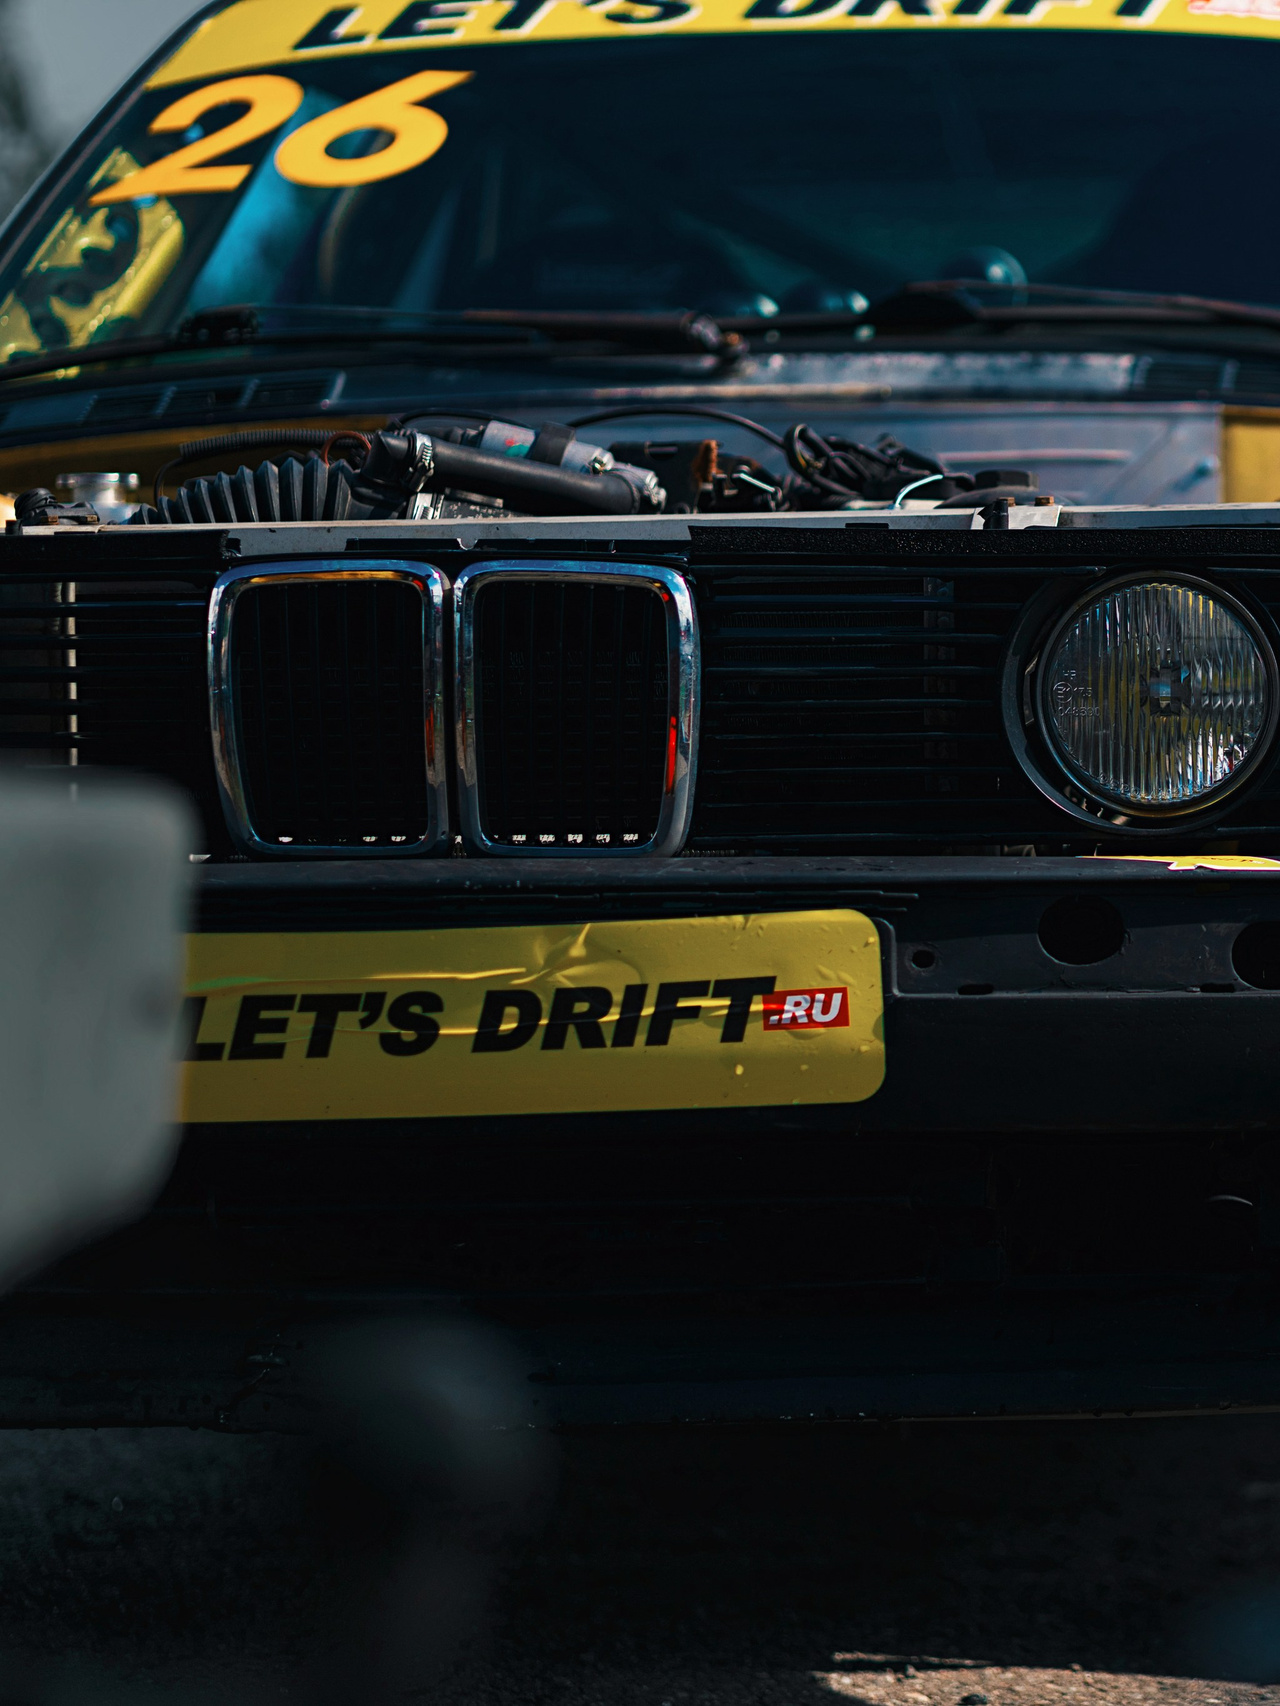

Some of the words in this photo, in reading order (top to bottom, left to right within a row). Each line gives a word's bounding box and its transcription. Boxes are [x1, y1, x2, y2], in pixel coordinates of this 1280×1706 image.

[89, 70, 474, 207] 26
[179, 991, 444, 1061] LET'S
[471, 976, 777, 1053] DRIFT
